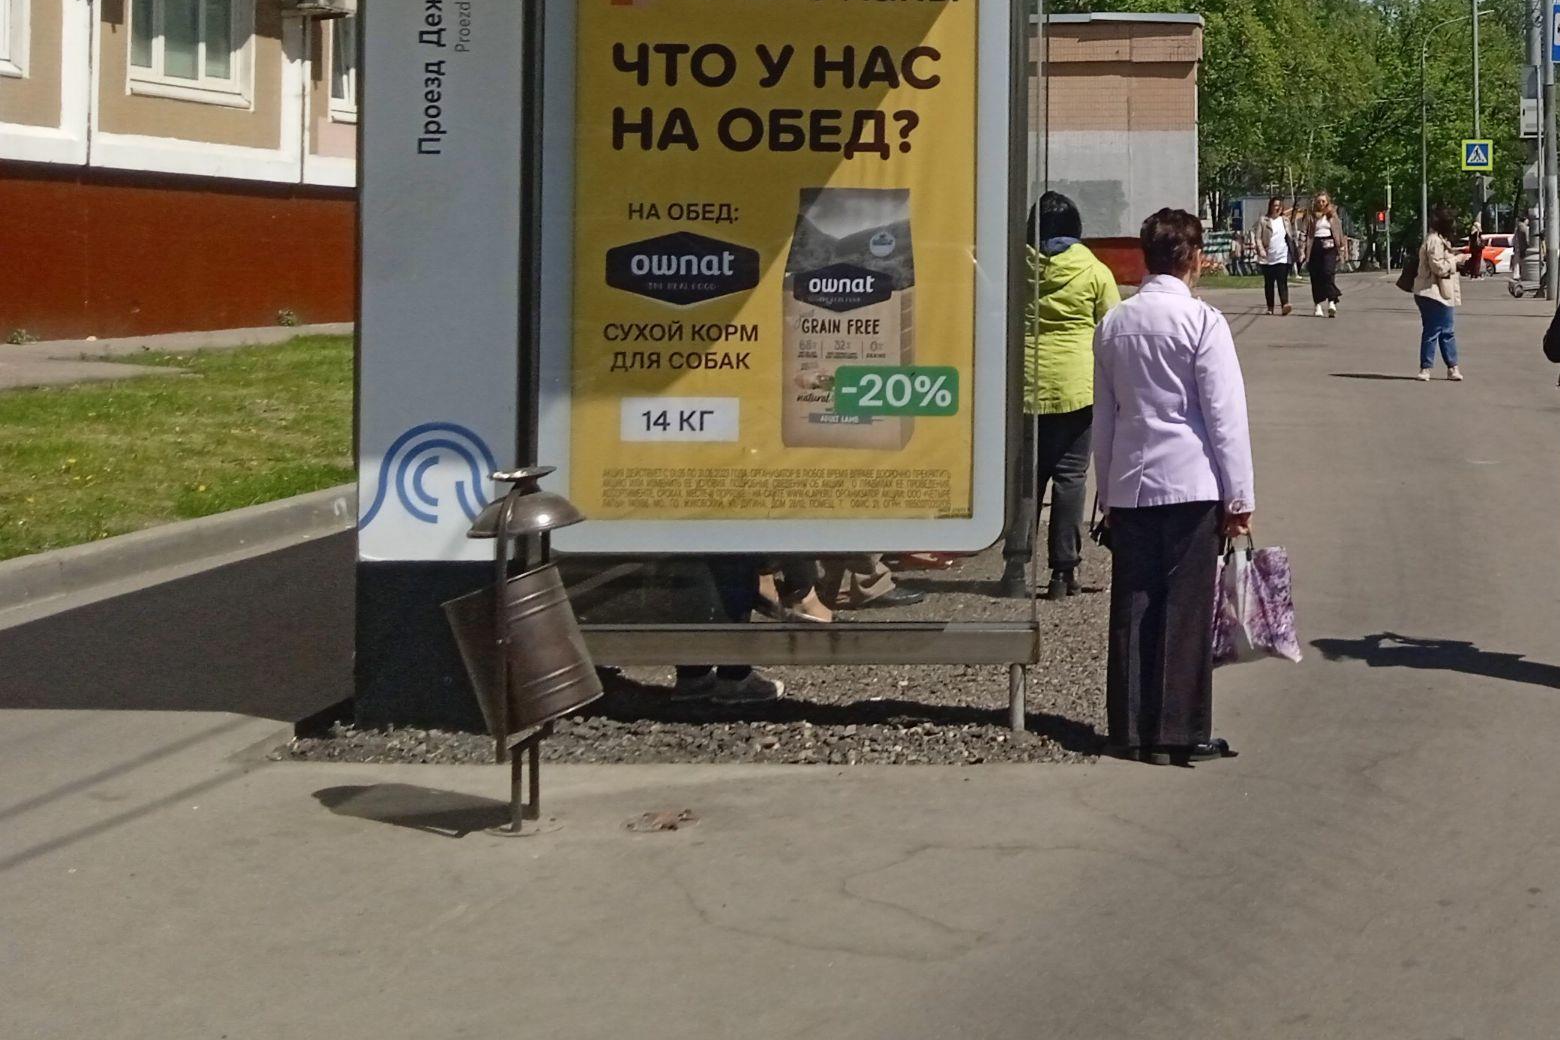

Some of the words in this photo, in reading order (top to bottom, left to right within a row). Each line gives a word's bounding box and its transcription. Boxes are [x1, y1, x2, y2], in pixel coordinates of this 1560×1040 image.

[455, 1, 473, 53] Proezd
[612, 42, 737, 88] ЧТО
[755, 43, 795, 90] У
[813, 44, 942, 90] НАС
[417, 60, 447, 155] Проезд
[612, 106, 700, 152] НА
[717, 107, 920, 160] ОБЕД?
[628, 203, 661, 221] НА
[667, 203, 740, 224] ОБЕД:
[630, 250, 735, 276] ownat
[808, 275, 875, 293] ownat
[603, 320, 686, 342] СУХОЙ
[692, 323, 759, 343] КОРМ
[801, 318, 841, 334] GRAIN
[847, 319, 880, 335] FREE
[610, 351, 663, 372] ДЛЯ
[672, 351, 751, 371] СОБАК
[841, 373, 953, 408] -20%
[642, 411, 671, 432] 14
[679, 411, 714, 432] КГ
